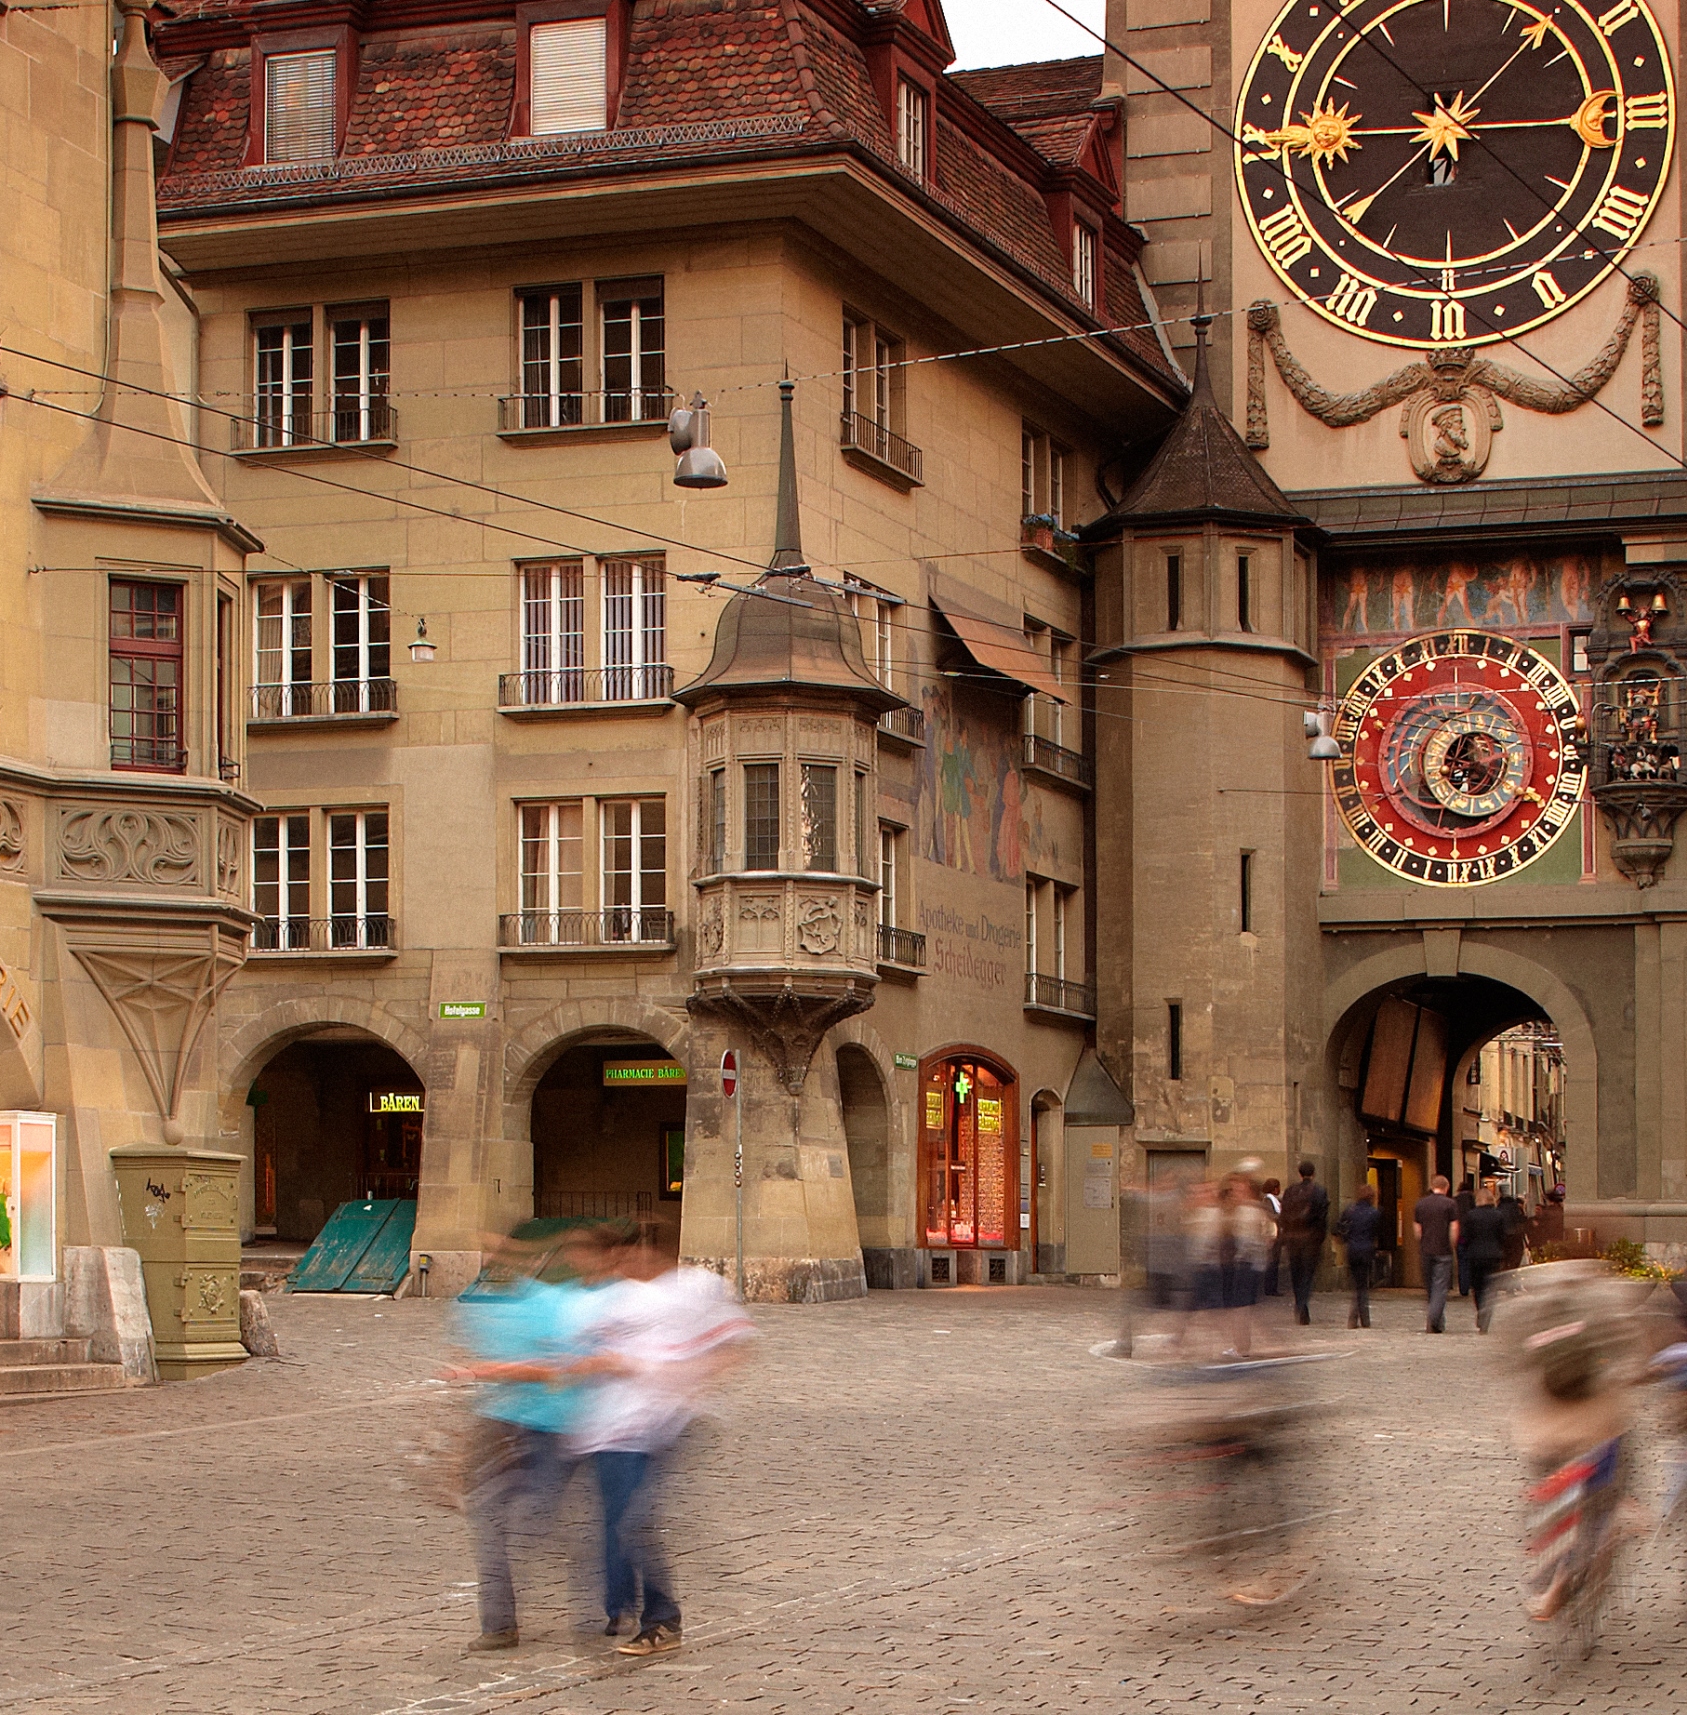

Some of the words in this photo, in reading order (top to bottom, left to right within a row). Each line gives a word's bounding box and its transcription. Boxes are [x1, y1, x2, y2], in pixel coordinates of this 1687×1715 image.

[1267, 33, 1303, 73] X
[1625, 90, 1668, 131] III
[1591, 184, 1650, 241] IIII
[918, 899, 964, 936] Apotheke
[981, 915, 1021, 953] Drogerie
[605, 1067, 654, 1079] PHARMACIE
[380, 1092, 420, 1111] BÄREN
